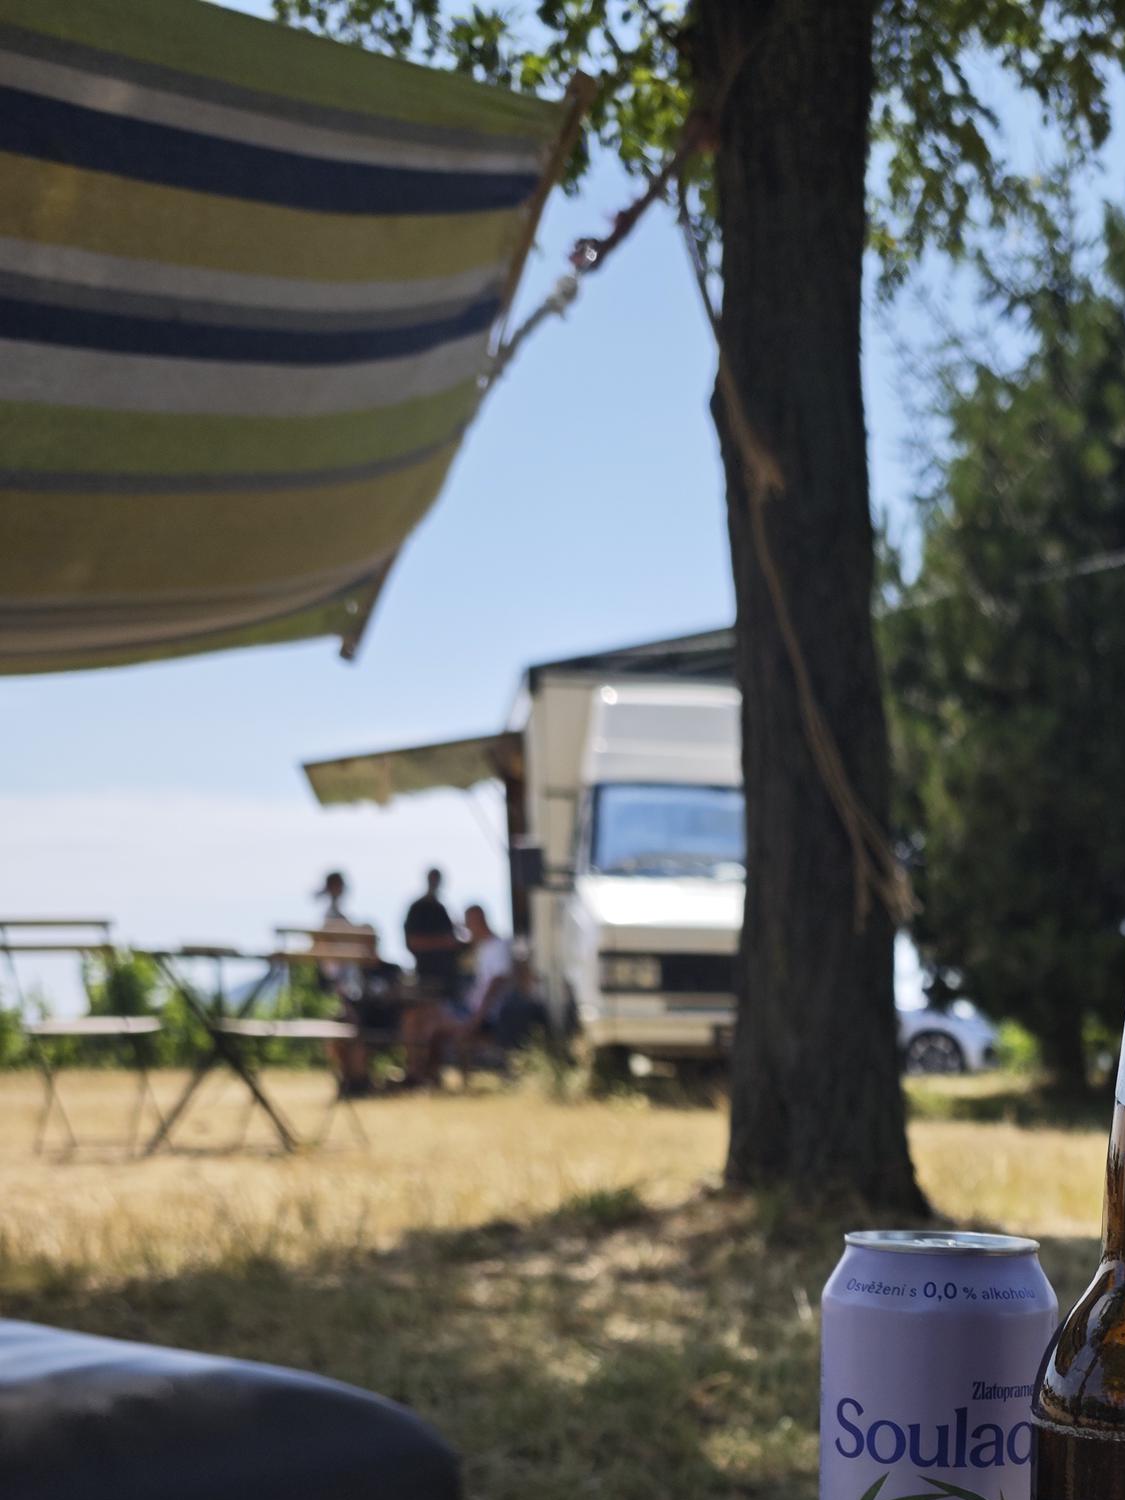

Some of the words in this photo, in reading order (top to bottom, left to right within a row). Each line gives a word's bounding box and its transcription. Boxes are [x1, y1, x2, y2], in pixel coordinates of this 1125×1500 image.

[846, 1278, 906, 1298] Osvěžení
[909, 1287, 917, 1298] s
[923, 1281, 957, 1302] 0,0
[963, 1286, 977, 1300] %
[982, 1286, 1036, 1301] alkoholu
